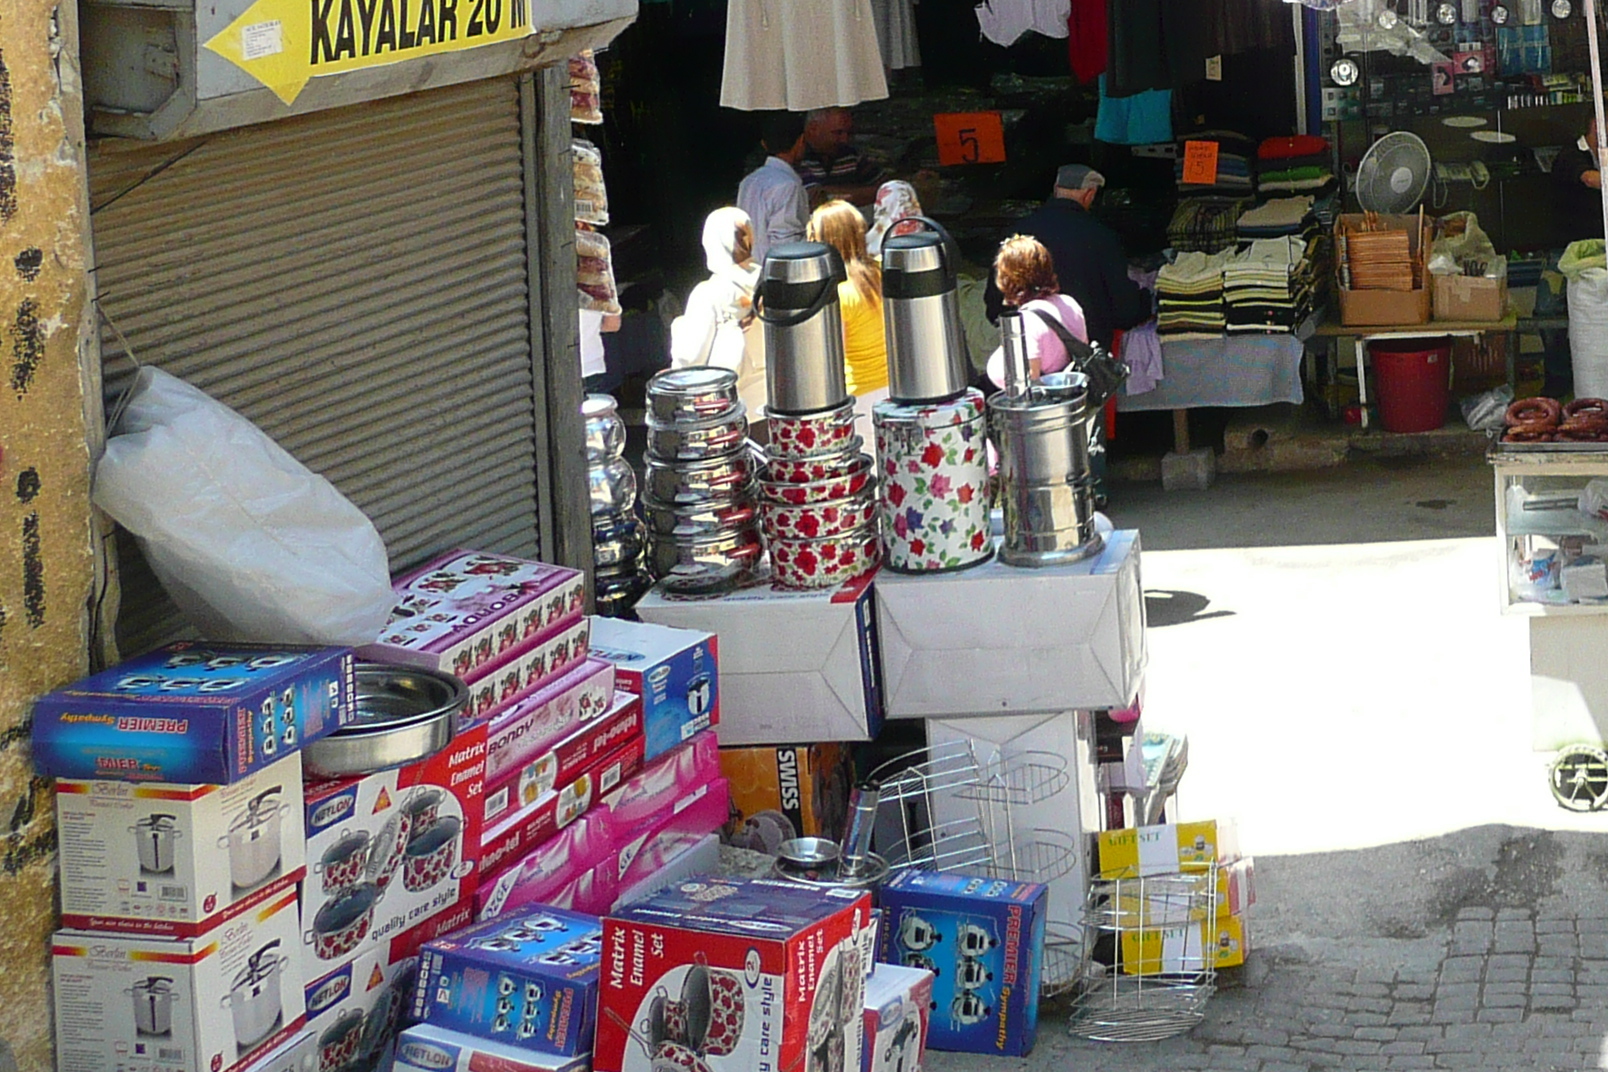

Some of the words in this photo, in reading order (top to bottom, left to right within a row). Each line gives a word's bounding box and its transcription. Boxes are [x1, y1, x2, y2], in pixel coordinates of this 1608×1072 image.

[958, 129, 979, 164] 5
[60, 712, 115, 725] Sympathy
[118, 717, 188, 734] PREMIER
[449, 741, 486, 767] Matrix
[452, 761, 484, 786] Enamel
[467, 781, 483, 797] Set
[778, 750, 799, 810] SWISS
[315, 795, 353, 823] NETLON
[1109, 834, 1137, 846] GIFT
[1140, 832, 1161, 842] SET
[372, 914, 405, 941] quality
[409, 903, 429, 918] care
[432, 888, 456, 907] style
[435, 907, 471, 936] Matrix
[611, 926, 626, 989] Matrix
[631, 929, 645, 986] Enamel
[650, 933, 664, 958] Set
[1005, 905, 1022, 985] PREMIER
[798, 940, 806, 1003] Matrix
[311, 976, 348, 1008] NETLON
[761, 976, 772, 1016] style
[996, 987, 1010, 1050] Sympathy
[761, 1022, 770, 1055] care
[403, 1045, 451, 1067] NETLON
